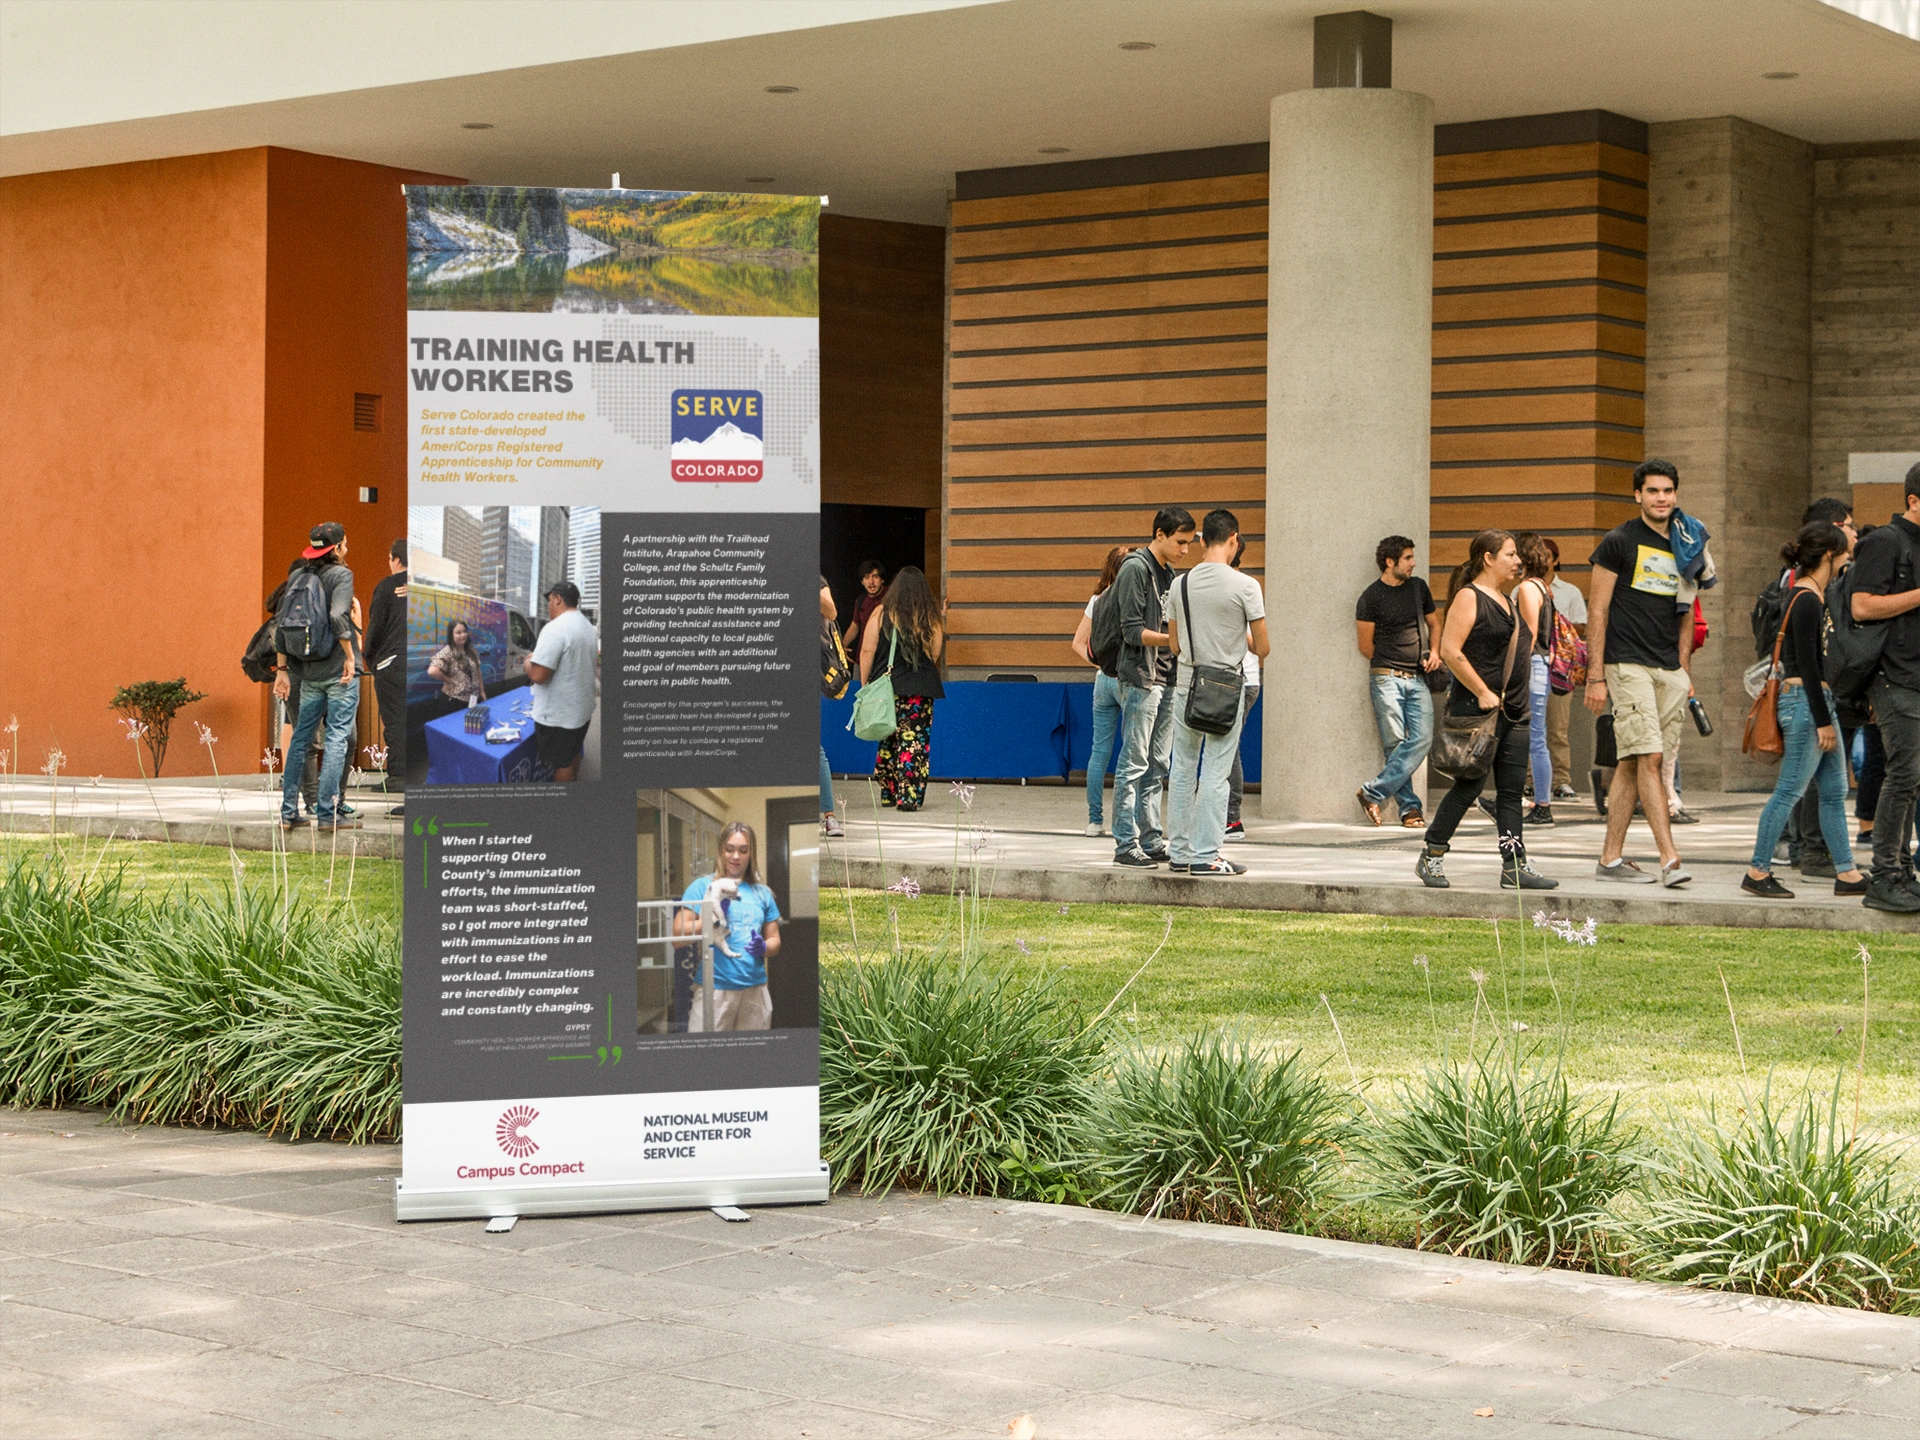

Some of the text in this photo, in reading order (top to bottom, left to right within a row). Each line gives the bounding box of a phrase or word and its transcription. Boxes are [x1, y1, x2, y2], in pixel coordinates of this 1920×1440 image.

[410, 337, 695, 365] TRAINING HEALTH
[410, 368, 574, 393] WORKERS
[676, 395, 759, 417] SERVE
[420, 408, 586, 422] Serve Colorado created the
[420, 424, 547, 439] first state-developed
[420, 440, 563, 455] AmeriCorps Registered
[420, 455, 604, 471] Apprenticeship for Community
[420, 470, 519, 483] Health Workers.
[675, 464, 759, 478] COLORADO
[622, 534, 770, 545] A partnership with the Trailhead
[623, 549, 765, 559] Institute, Arapahoe Community
[623, 563, 766, 574] College, and the Schultz Family
[623, 577, 767, 588] Foundation, this apprenticeship
[622, 591, 790, 603] program supports the modernization
[623, 606, 794, 616] of Colorado's public health system by
[622, 619, 780, 630] providing technical assistance and
[623, 634, 669, 643] additional
[670, 634, 710, 644] capacity
[723, 634, 745, 642] local
[746, 634, 775, 644] public
[623, 648, 778, 659] health agencies with an additional
[623, 661, 791, 674] end goal of members pursuing future
[623, 676, 732, 687] careers in public health.
[441, 834, 533, 846] When I started
[441, 851, 547, 865] supporting Otero
[441, 867, 581, 882] County’s immunization
[441, 884, 596, 898] efforts, the immunization
[441, 900, 589, 914] team was short-staffed,
[441, 916, 588, 932] so I got more integrated
[441, 934, 593, 948] with immunizations in an
[441, 952, 548, 965] effort to ease the
[441, 968, 595, 983] workload. Immunizations
[441, 985, 579, 1000] are incredibly complex
[441, 1002, 594, 1016] and constantly changing.
[565, 1023, 591, 1032] GYPSY
[643, 1110, 769, 1128] NATIONAL MUSEUM
[643, 1127, 752, 1144] AND CENTER FOR
[643, 1146, 696, 1160] SERVICE
[456, 1160, 585, 1181] Campus Compact
